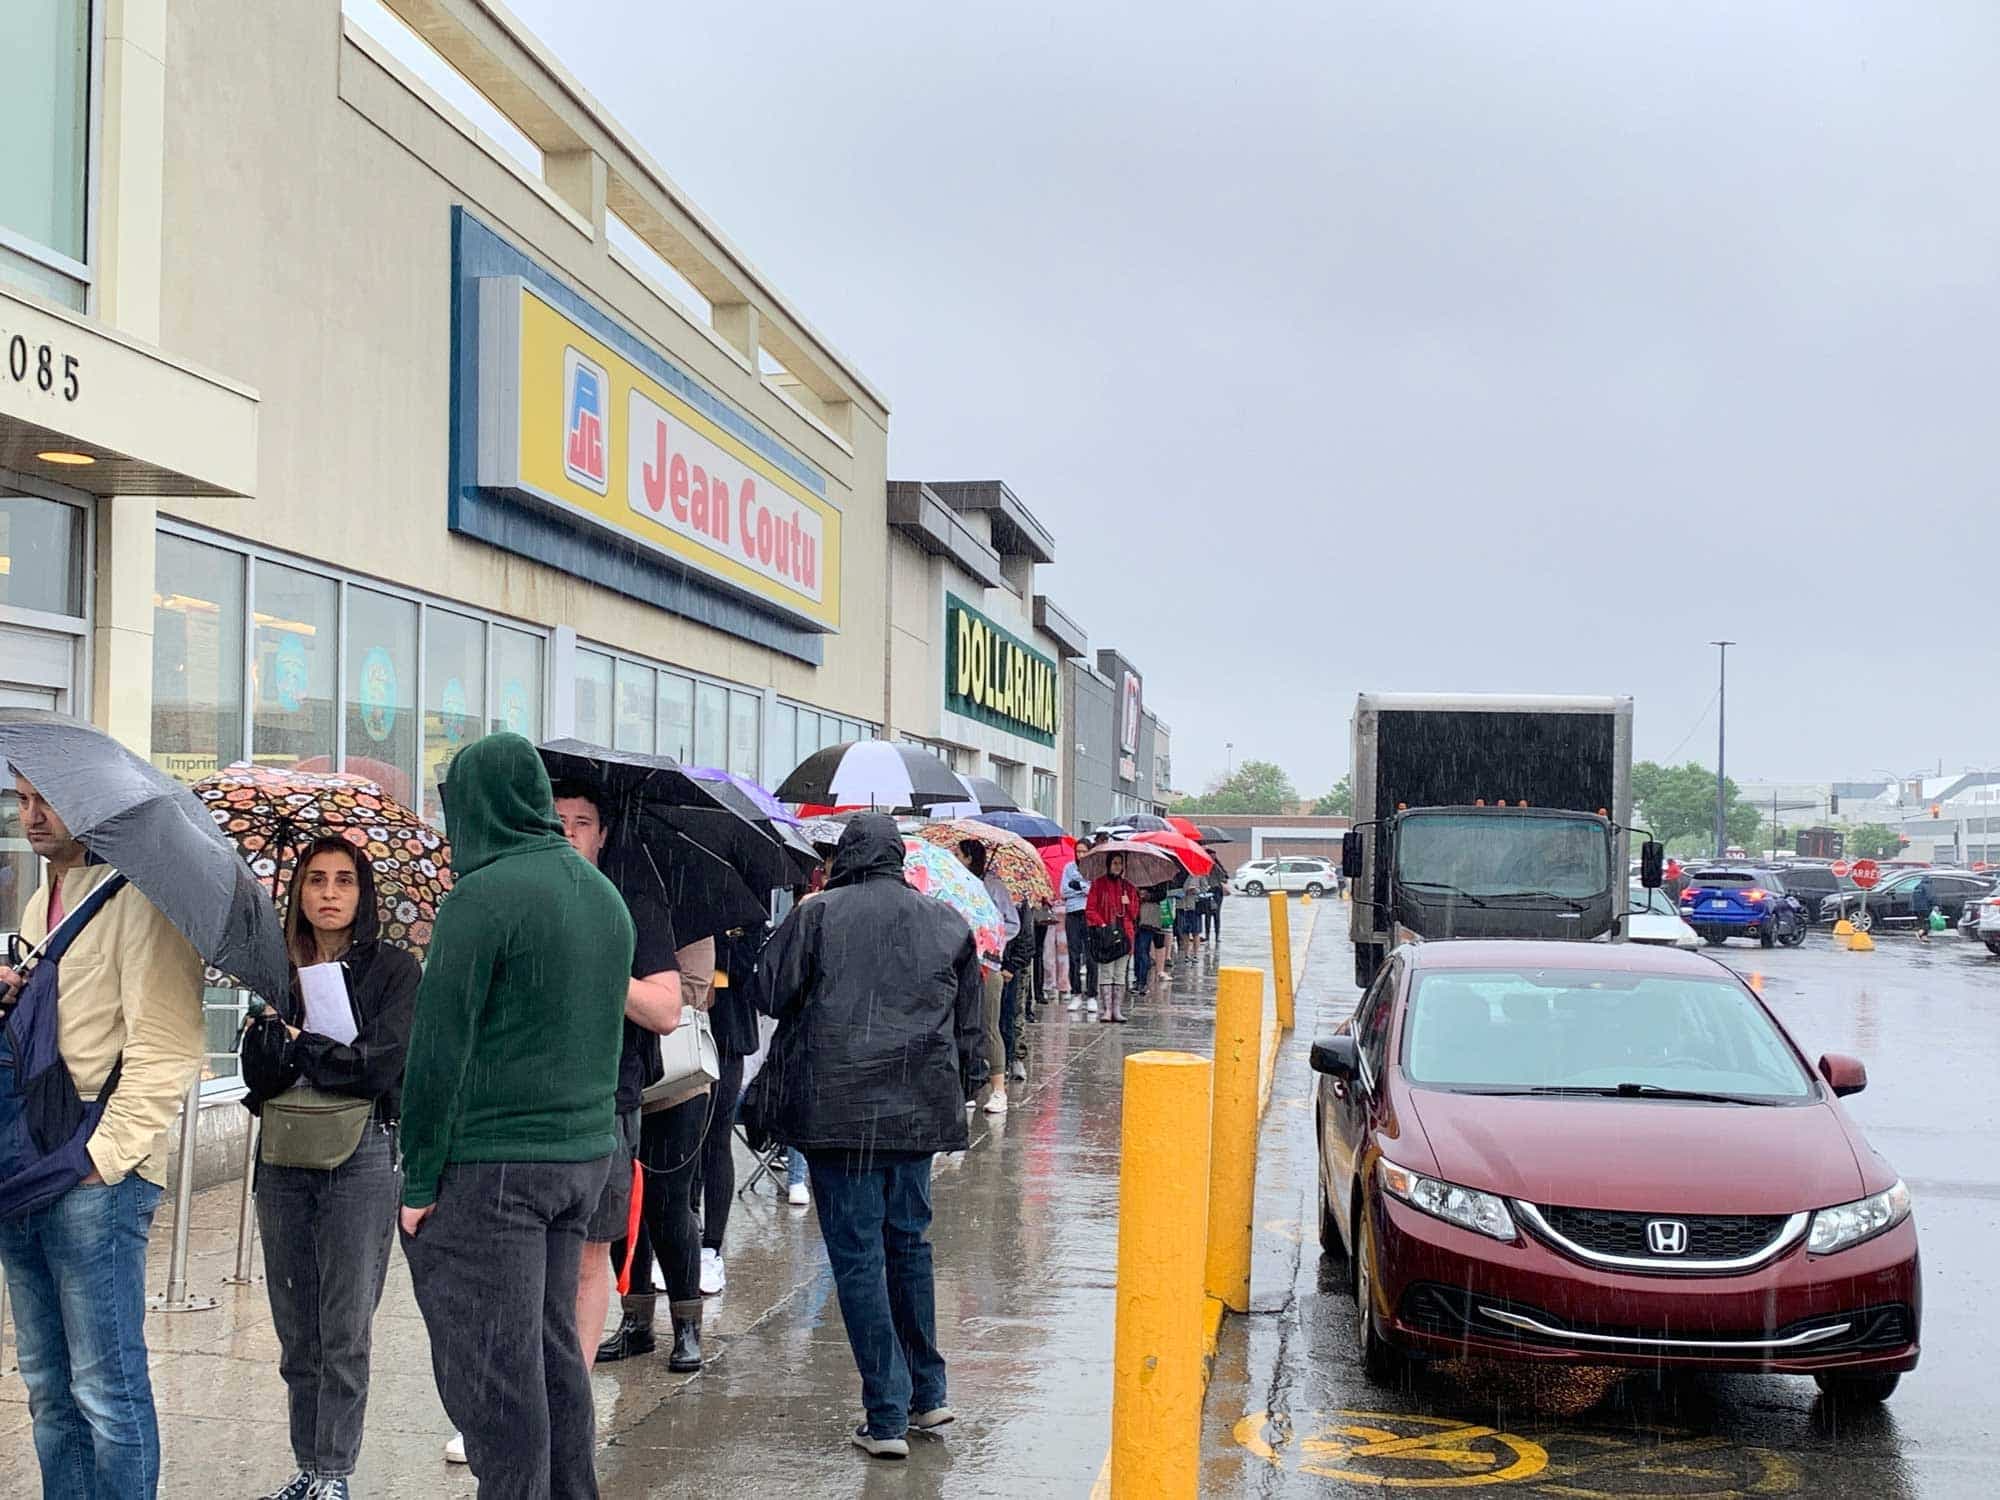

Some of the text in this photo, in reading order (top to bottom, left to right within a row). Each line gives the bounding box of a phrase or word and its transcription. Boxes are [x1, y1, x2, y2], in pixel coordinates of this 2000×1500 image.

[10, 334, 80, 402] 085
[643, 419, 816, 590] Jean Coutu
[958, 609, 1054, 735] DOLLARAMA
